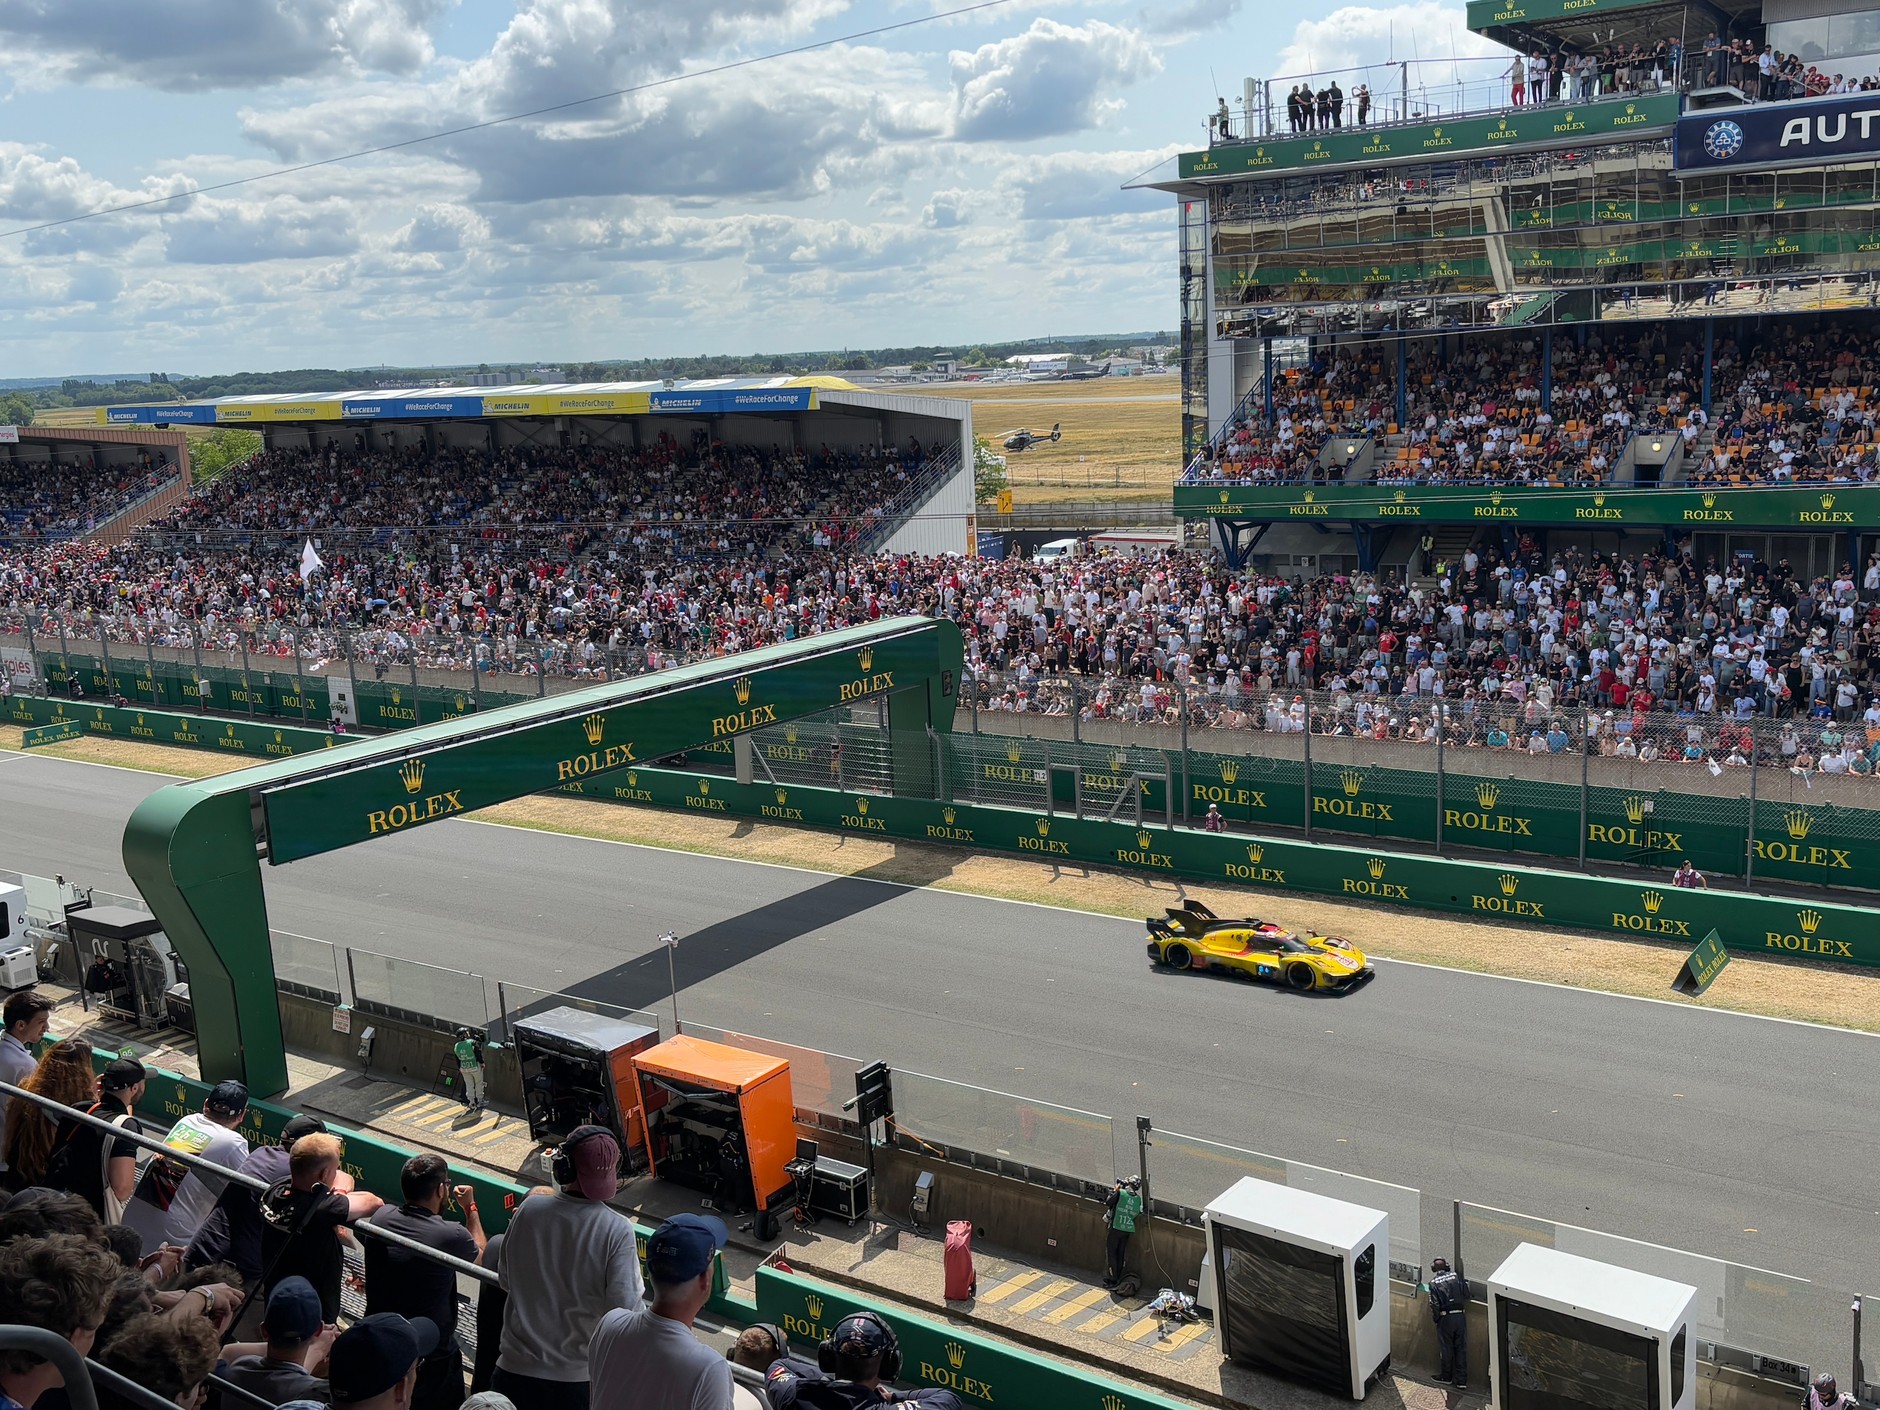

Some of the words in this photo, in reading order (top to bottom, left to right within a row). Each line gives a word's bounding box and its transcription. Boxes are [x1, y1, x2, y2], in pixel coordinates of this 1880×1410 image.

[1563, 0, 1597, 10] ROLEX
[1494, 9, 1525, 21] ROLEX
[1613, 114, 1646, 125] ROLEX
[1553, 121, 1585, 132] ROLEX
[1487, 129, 1517, 140] ROLEX
[1423, 137, 1452, 147] ROLEX
[1363, 144, 1390, 154] ROLEX
[1247, 157, 1273, 166] ROLEX
[1303, 151, 1331, 160] ROLEX
[1193, 162, 1218, 172] ROLEX
[560, 399, 615, 409] #WeRaceForChange
[735, 394, 799, 405] #WeRaceForChange
[405, 402, 453, 412] #WeRaceForChange
[494, 402, 530, 411] MICHELIN
[224, 410, 252, 419] MICHELIN
[1206, 505, 1243, 514] ROLEX
[1289, 505, 1328, 515] ROLEX
[1379, 505, 1421, 516] ROLEX
[1474, 506, 1519, 517] ROLEX
[1575, 507, 1623, 519] ROLEX
[1683, 508, 1734, 521] ROLEX
[1800, 511, 1855, 523] ROLEX
[136, 680, 164, 693] ROLX
[839, 671, 894, 701] ROLEX
[379, 705, 416, 720] ROLEX
[711, 703, 777, 737] ROLEX
[90, 721, 113, 732] ROLEX
[131, 726, 154, 737] ROLEX
[30, 736, 54, 745] ROLEX
[174, 731, 198, 743] ROLEX
[219, 737, 244, 749] ROLEX
[266, 743, 294, 755] ROLEX
[557, 742, 637, 781] ROLEX
[614, 786, 651, 801] ROLEX
[1193, 784, 1268, 808] ROLEX
[685, 795, 725, 810] ROLEX
[1312, 796, 1394, 821] ROLEX
[367, 789, 465, 834] ROLEX
[761, 804, 803, 820] ROLEX
[841, 814, 887, 831] ROLEX
[1444, 809, 1533, 836] ROLEX
[926, 825, 975, 841] ROLEX
[1588, 823, 1684, 852] ROLEX
[1018, 836, 1070, 855] ROLEX
[1117, 849, 1174, 868] ROLEX
[1745, 839, 1852, 869] ROLEX
[1224, 863, 1287, 883] ROLEX
[1342, 878, 1410, 900] ROLEX
[1472, 894, 1545, 918] ROLEX
[17, 914, 24, 925] 6
[1612, 912, 1691, 936] ROLEX
[1764, 932, 1853, 958] ROLEX
[1762, 1357, 1778, 1370] Box
[919, 1360, 994, 1402] ROLEX
